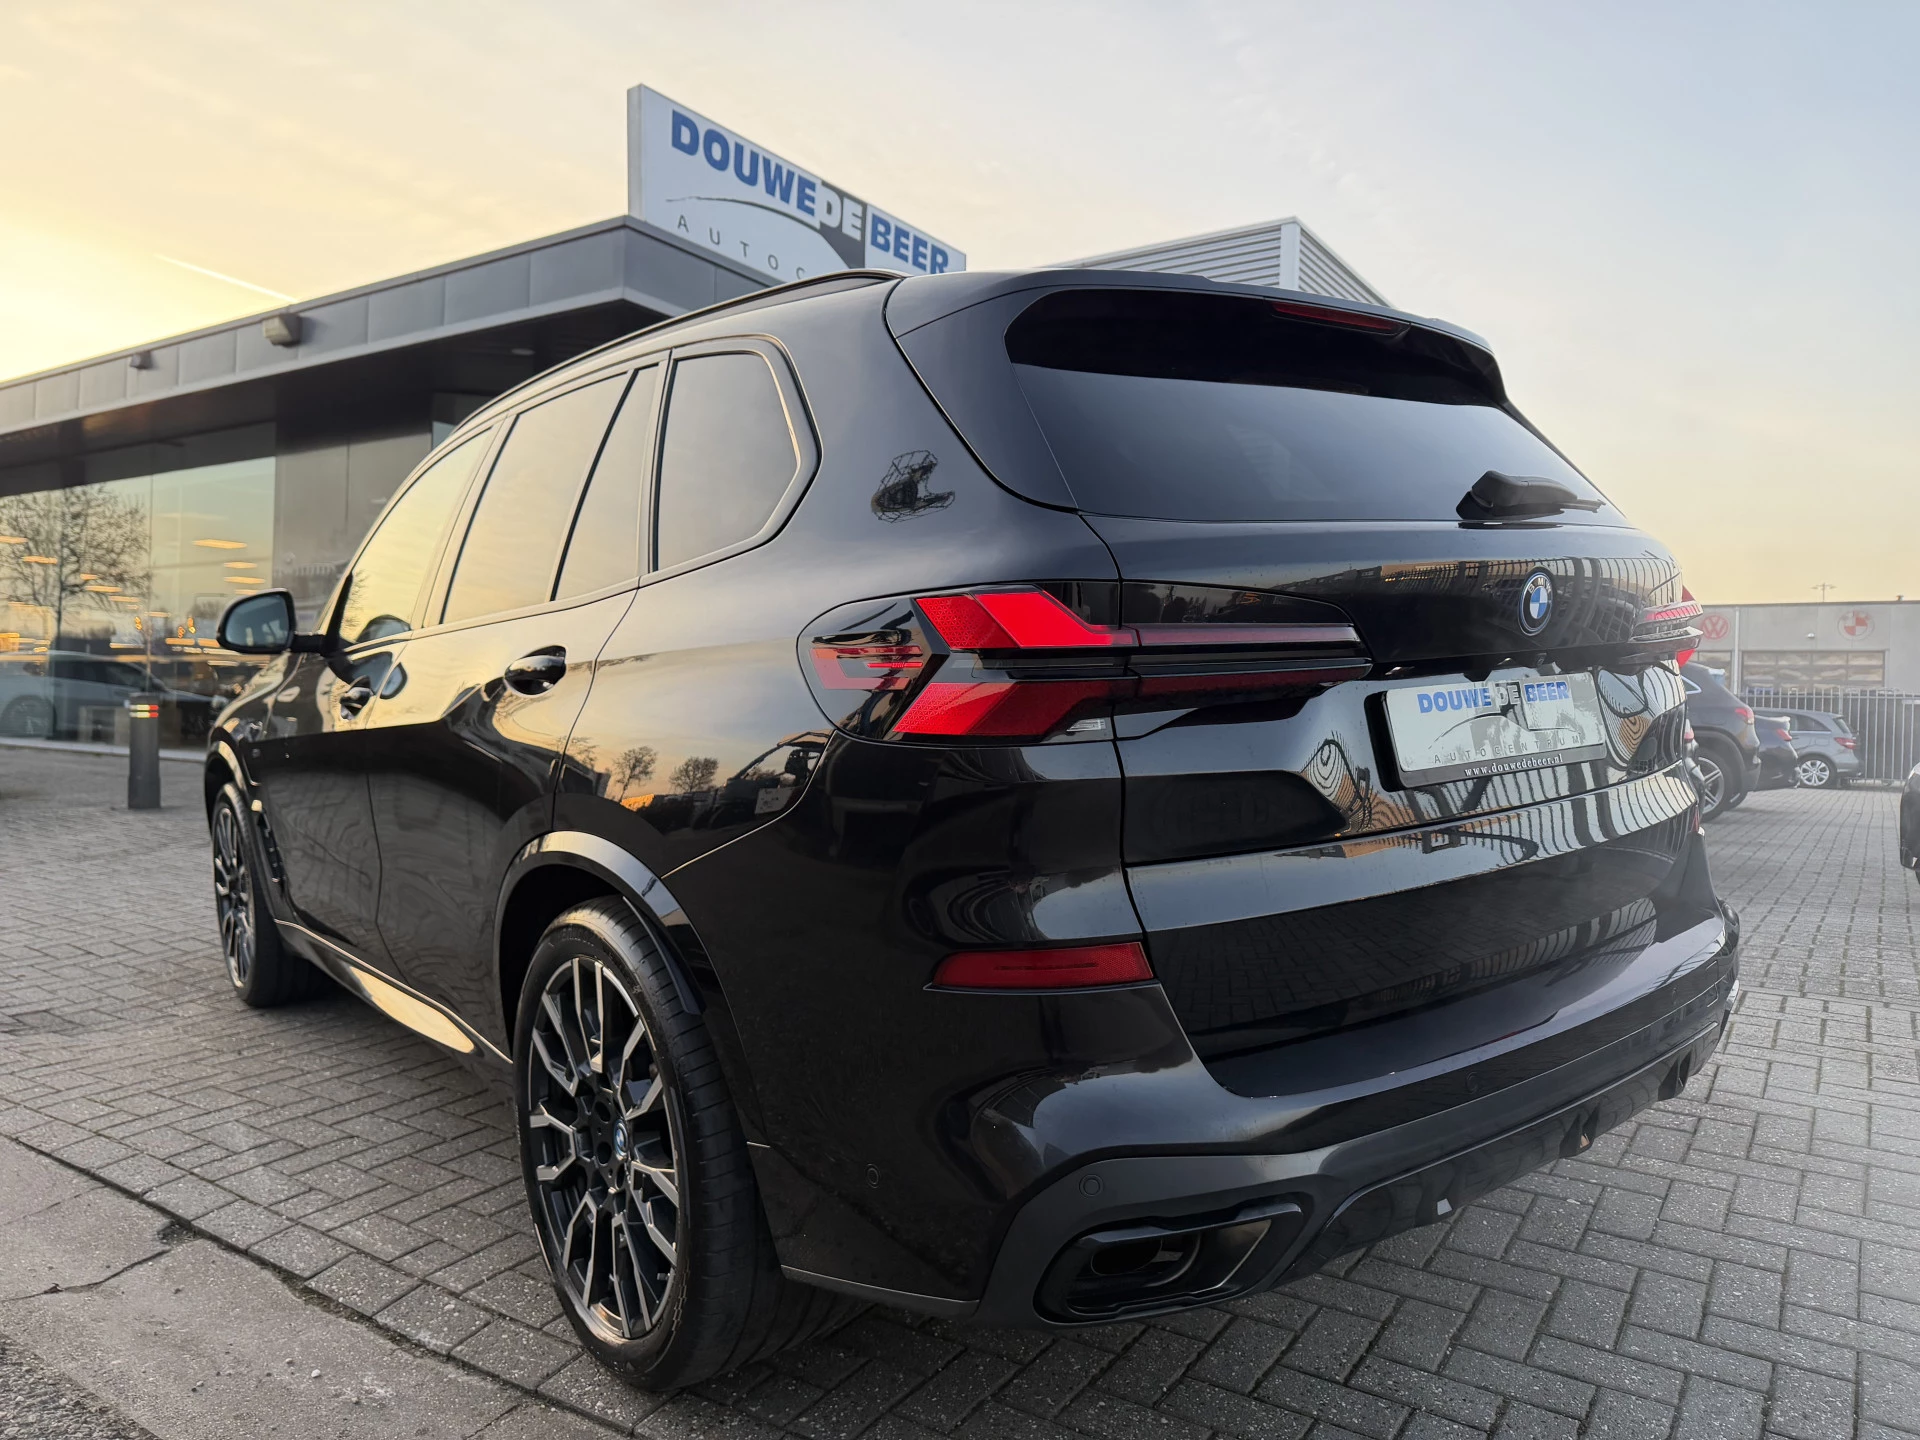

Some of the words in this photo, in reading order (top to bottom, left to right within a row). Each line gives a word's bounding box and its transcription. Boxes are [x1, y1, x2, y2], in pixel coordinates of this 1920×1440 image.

[671, 108, 817, 218] DOUWE
[820, 184, 863, 241] DE
[870, 212, 949, 274] BEER
[1527, 577, 1552, 594] BMW
[1416, 687, 1492, 714] DOUWE
[1495, 682, 1520, 706] DE
[1524, 681, 1569, 703] BEER
[1433, 735, 1582, 765] AUTOCENTRUM
[1464, 753, 1564, 777] www.douwedebeer.nl
